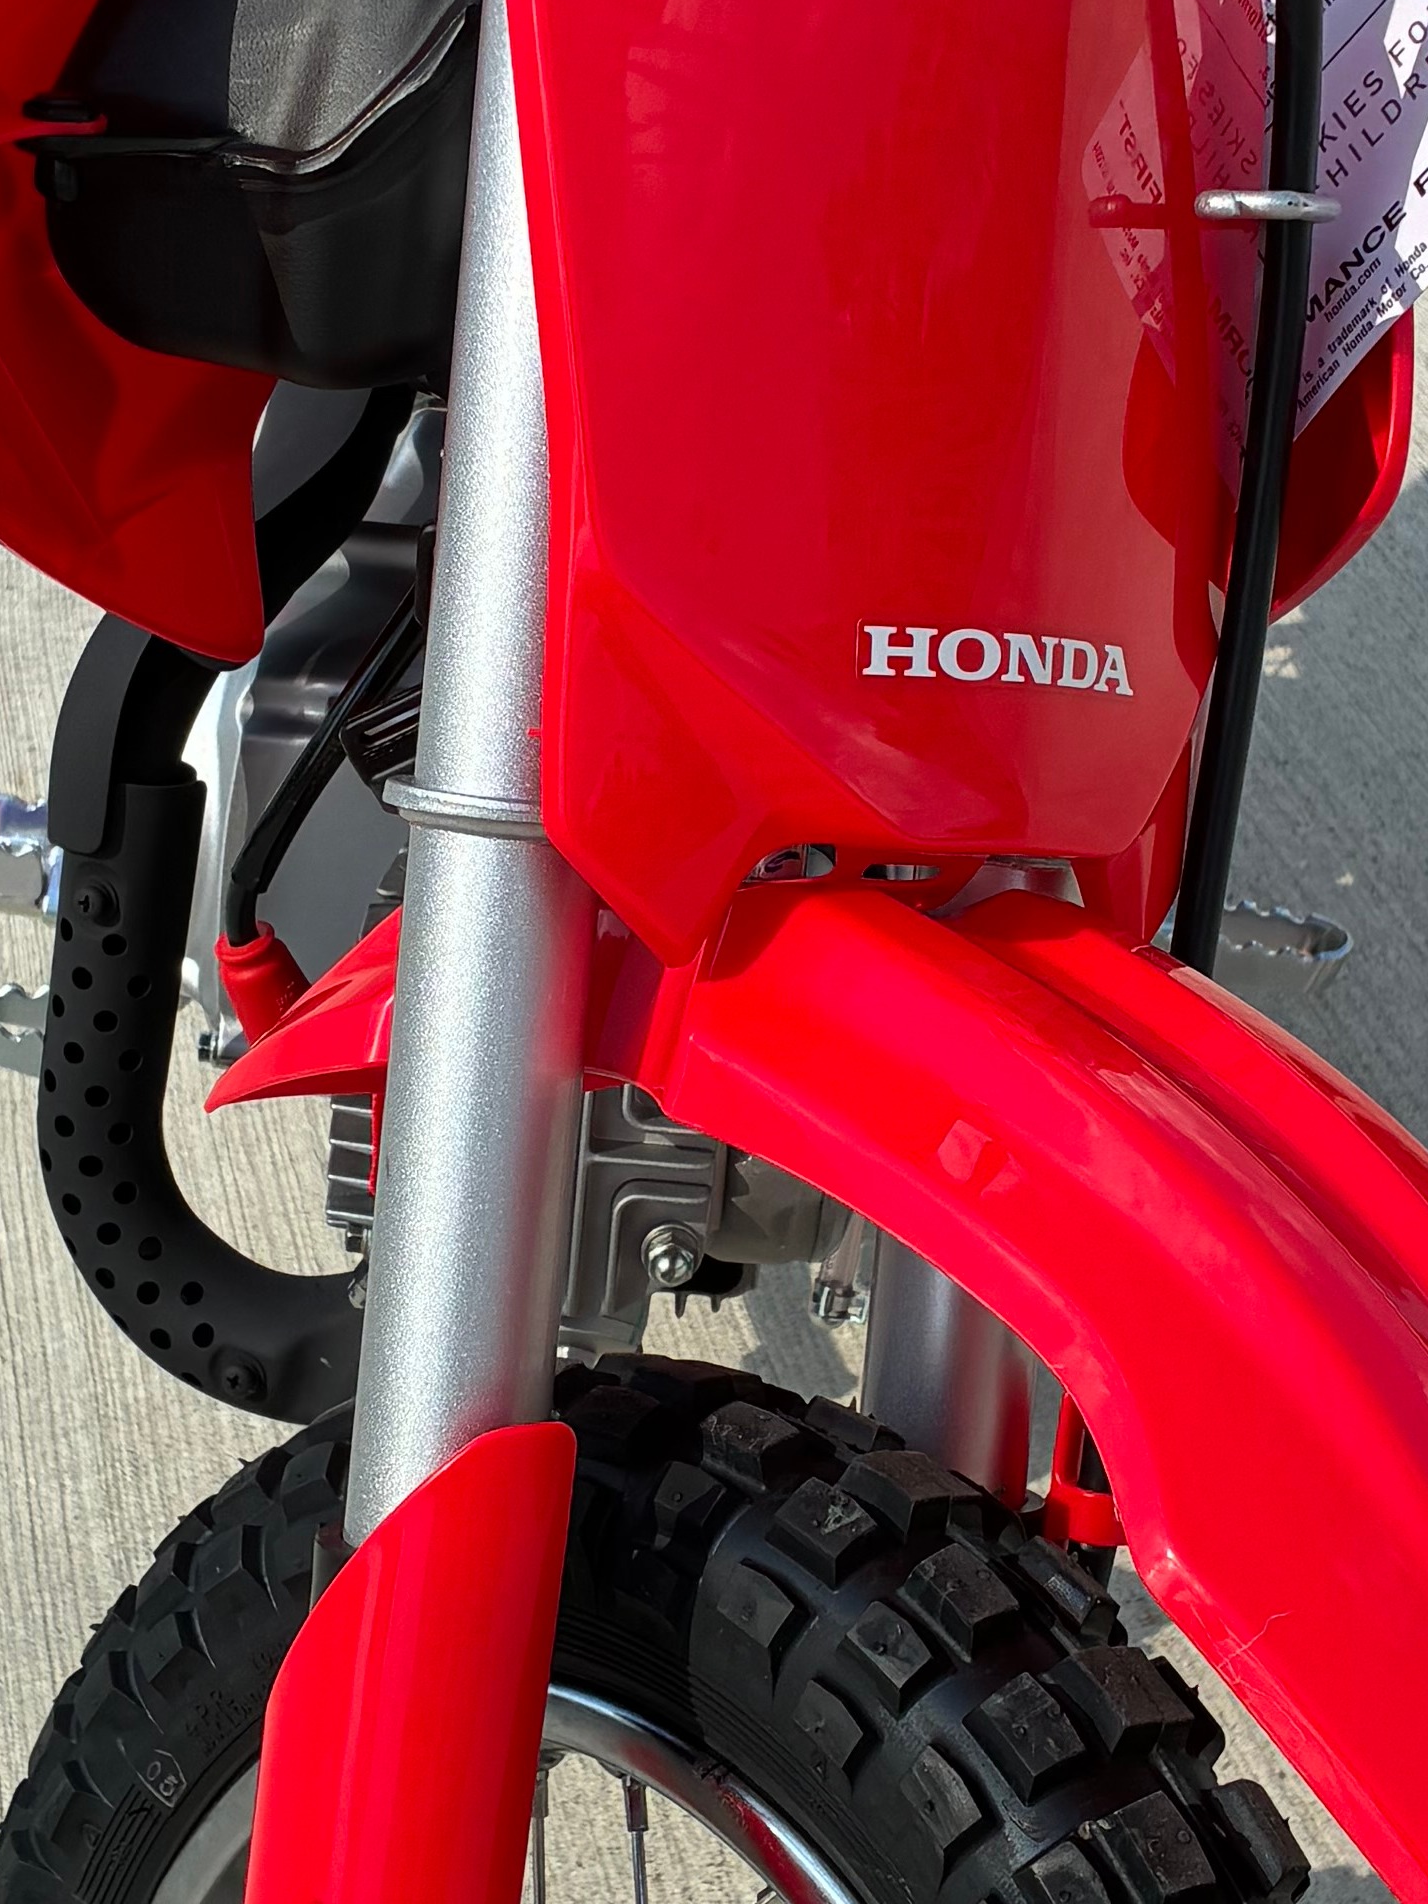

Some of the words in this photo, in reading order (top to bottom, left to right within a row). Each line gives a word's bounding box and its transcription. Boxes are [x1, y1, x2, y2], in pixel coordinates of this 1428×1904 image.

[1318, 70, 1383, 152] KIES
[1324, 256, 1382, 323] honda.com
[1327, 295, 1378, 354] trademark
[1394, 242, 1427, 278] Honda
[1341, 320, 1375, 358] Honda
[1375, 283, 1408, 319] Motor
[862, 625, 1134, 696] HONDA
